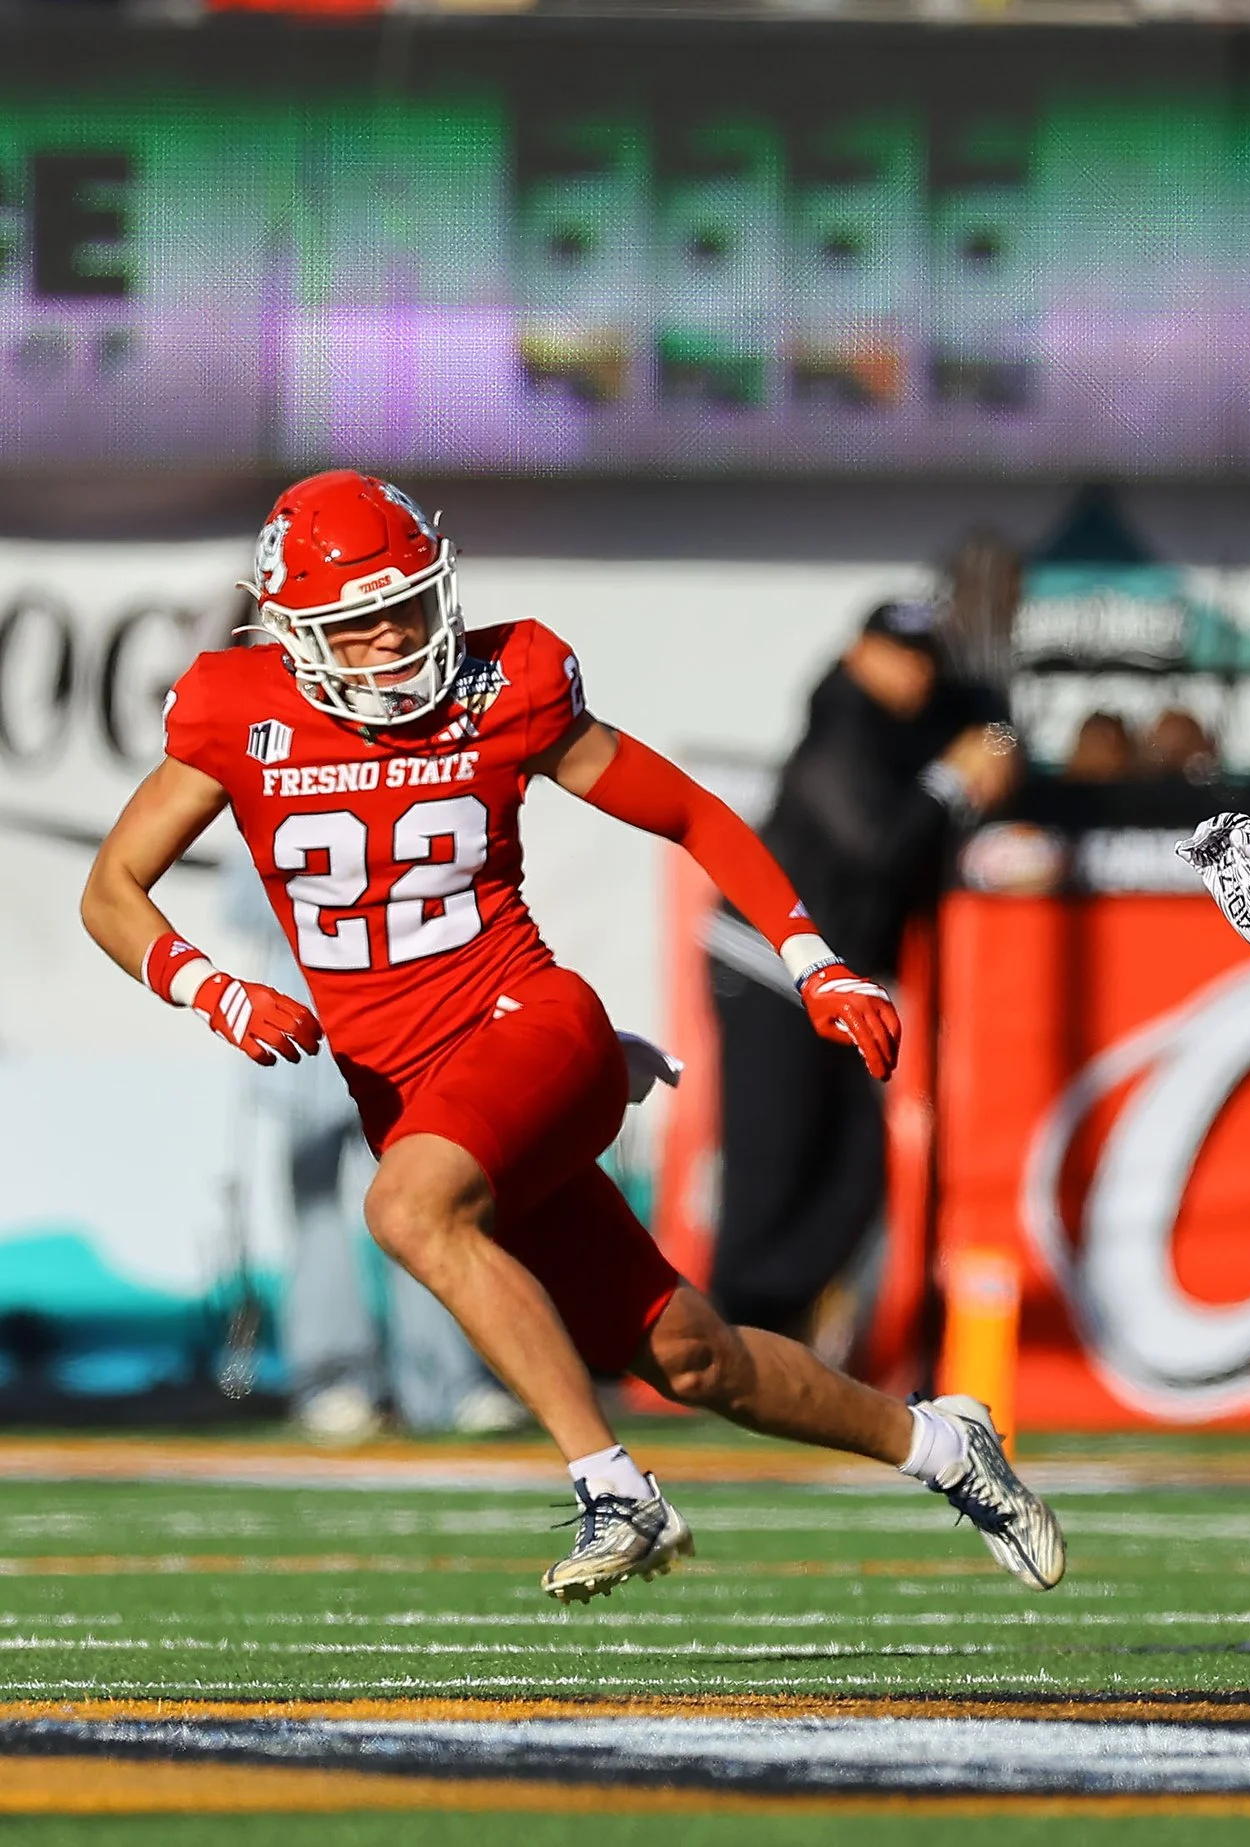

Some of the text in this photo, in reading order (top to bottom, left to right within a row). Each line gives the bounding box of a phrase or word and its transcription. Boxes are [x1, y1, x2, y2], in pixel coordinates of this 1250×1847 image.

[262, 750, 480, 797] FRESNO STATE
[273, 795, 488, 970] 22
